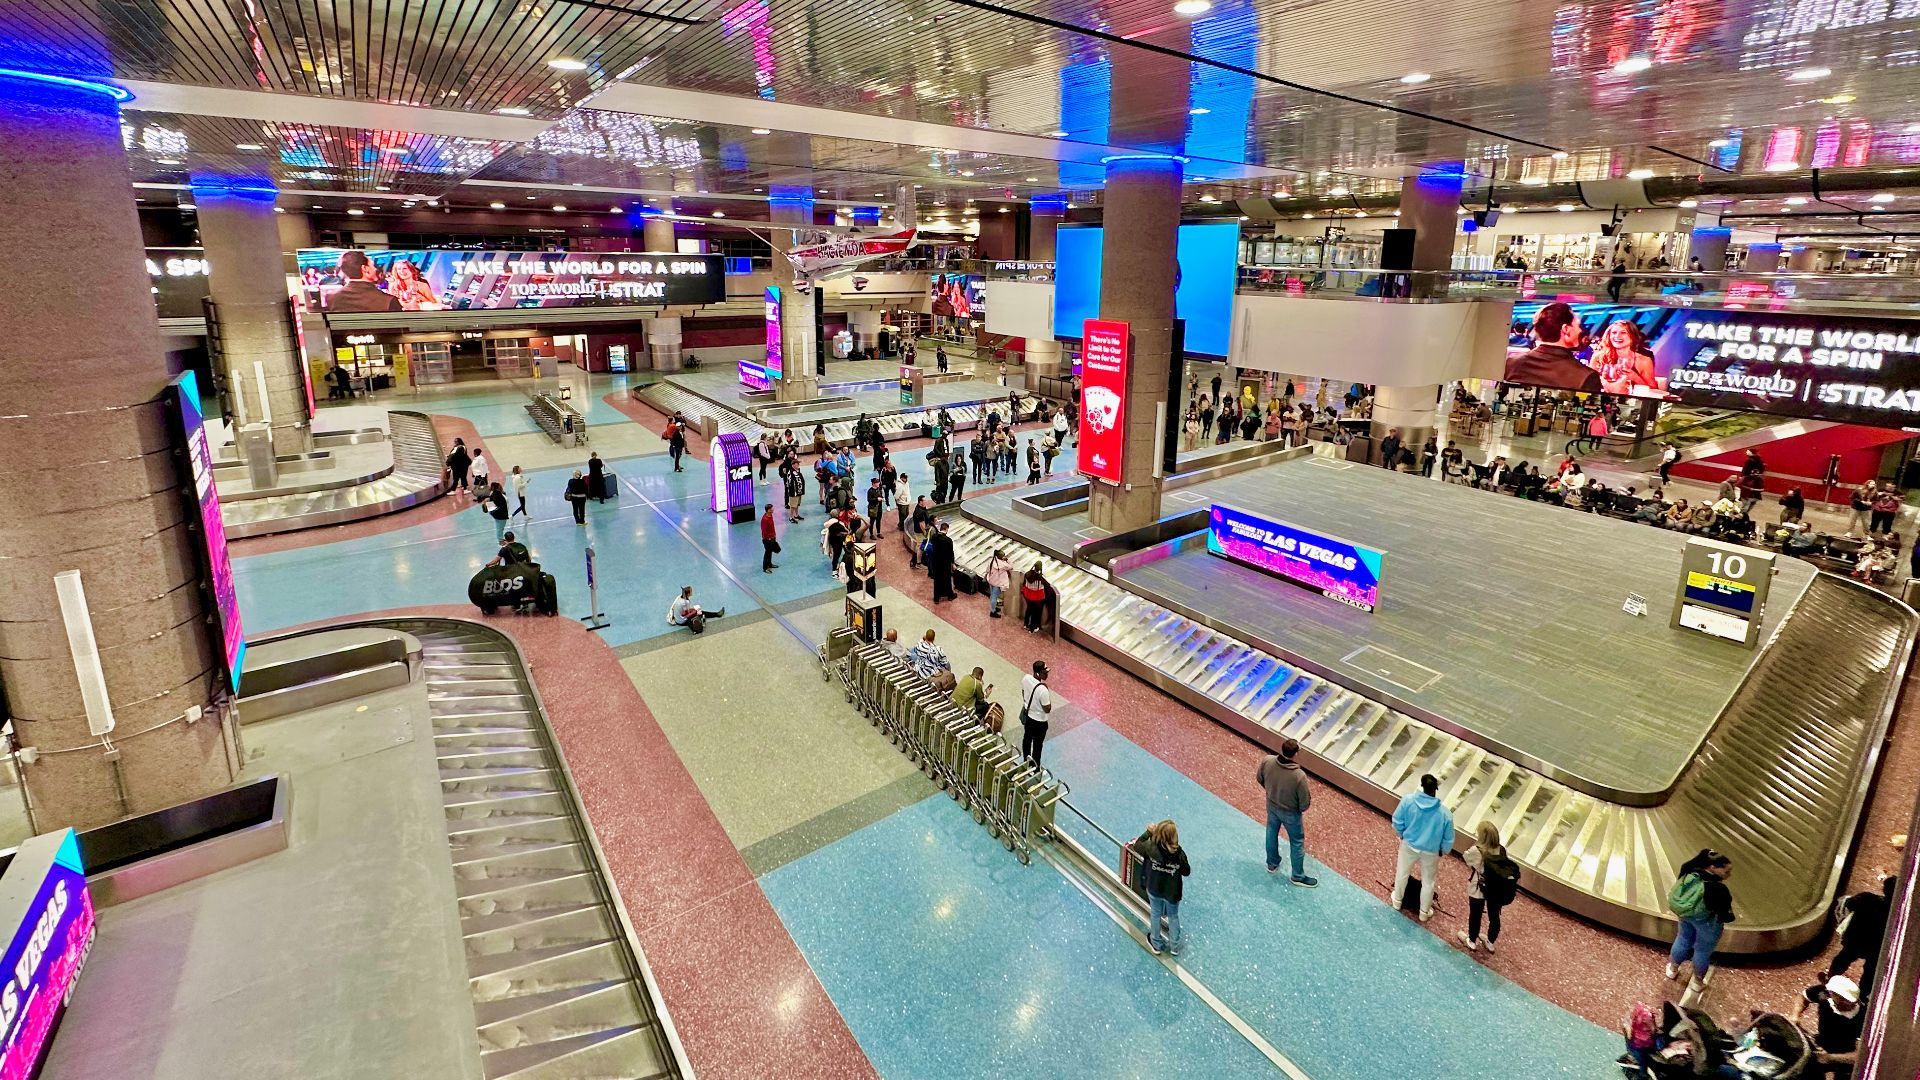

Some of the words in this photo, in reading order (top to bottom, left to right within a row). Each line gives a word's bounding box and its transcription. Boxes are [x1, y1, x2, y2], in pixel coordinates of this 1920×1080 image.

[166, 259, 210, 276] SPI
[452, 261, 504, 275] TAKE
[508, 261, 546, 275] THE
[549, 261, 615, 275] WORLD
[619, 261, 651, 275] FOR
[653, 261, 668, 275] A
[671, 261, 707, 275] SPIN
[509, 283, 537, 295] TOP
[548, 276, 595, 295] WORLD
[614, 281, 666, 298] STRAT
[1090, 335, 1111, 345] There's
[1112, 337, 1120, 346] No
[1684, 322, 1752, 341] TAKE
[1758, 326, 1814, 346] THE
[1087, 352, 1100, 361] Care
[1101, 354, 1110, 362] for
[1110, 355, 1121, 363] Our
[1088, 344, 1103, 352] Limit
[1103, 345, 1109, 353] to
[1110, 346, 1121, 354] Our
[1720, 342, 1777, 362] FOR
[1781, 346, 1803, 363] A
[1810, 348, 1883, 370] SPIN
[1087, 361, 1120, 373] Customers!
[1672, 369, 1710, 383] TOP
[1725, 369, 1797, 392] WORLD
[1227, 519, 1256, 534] WELCOME
[1256, 527, 1266, 537] TO
[1263, 531, 1297, 551] LAS
[1299, 541, 1357, 571] VEGAS
[1707, 551, 1747, 579] 10
[15, 878, 68, 991] VEGAS
